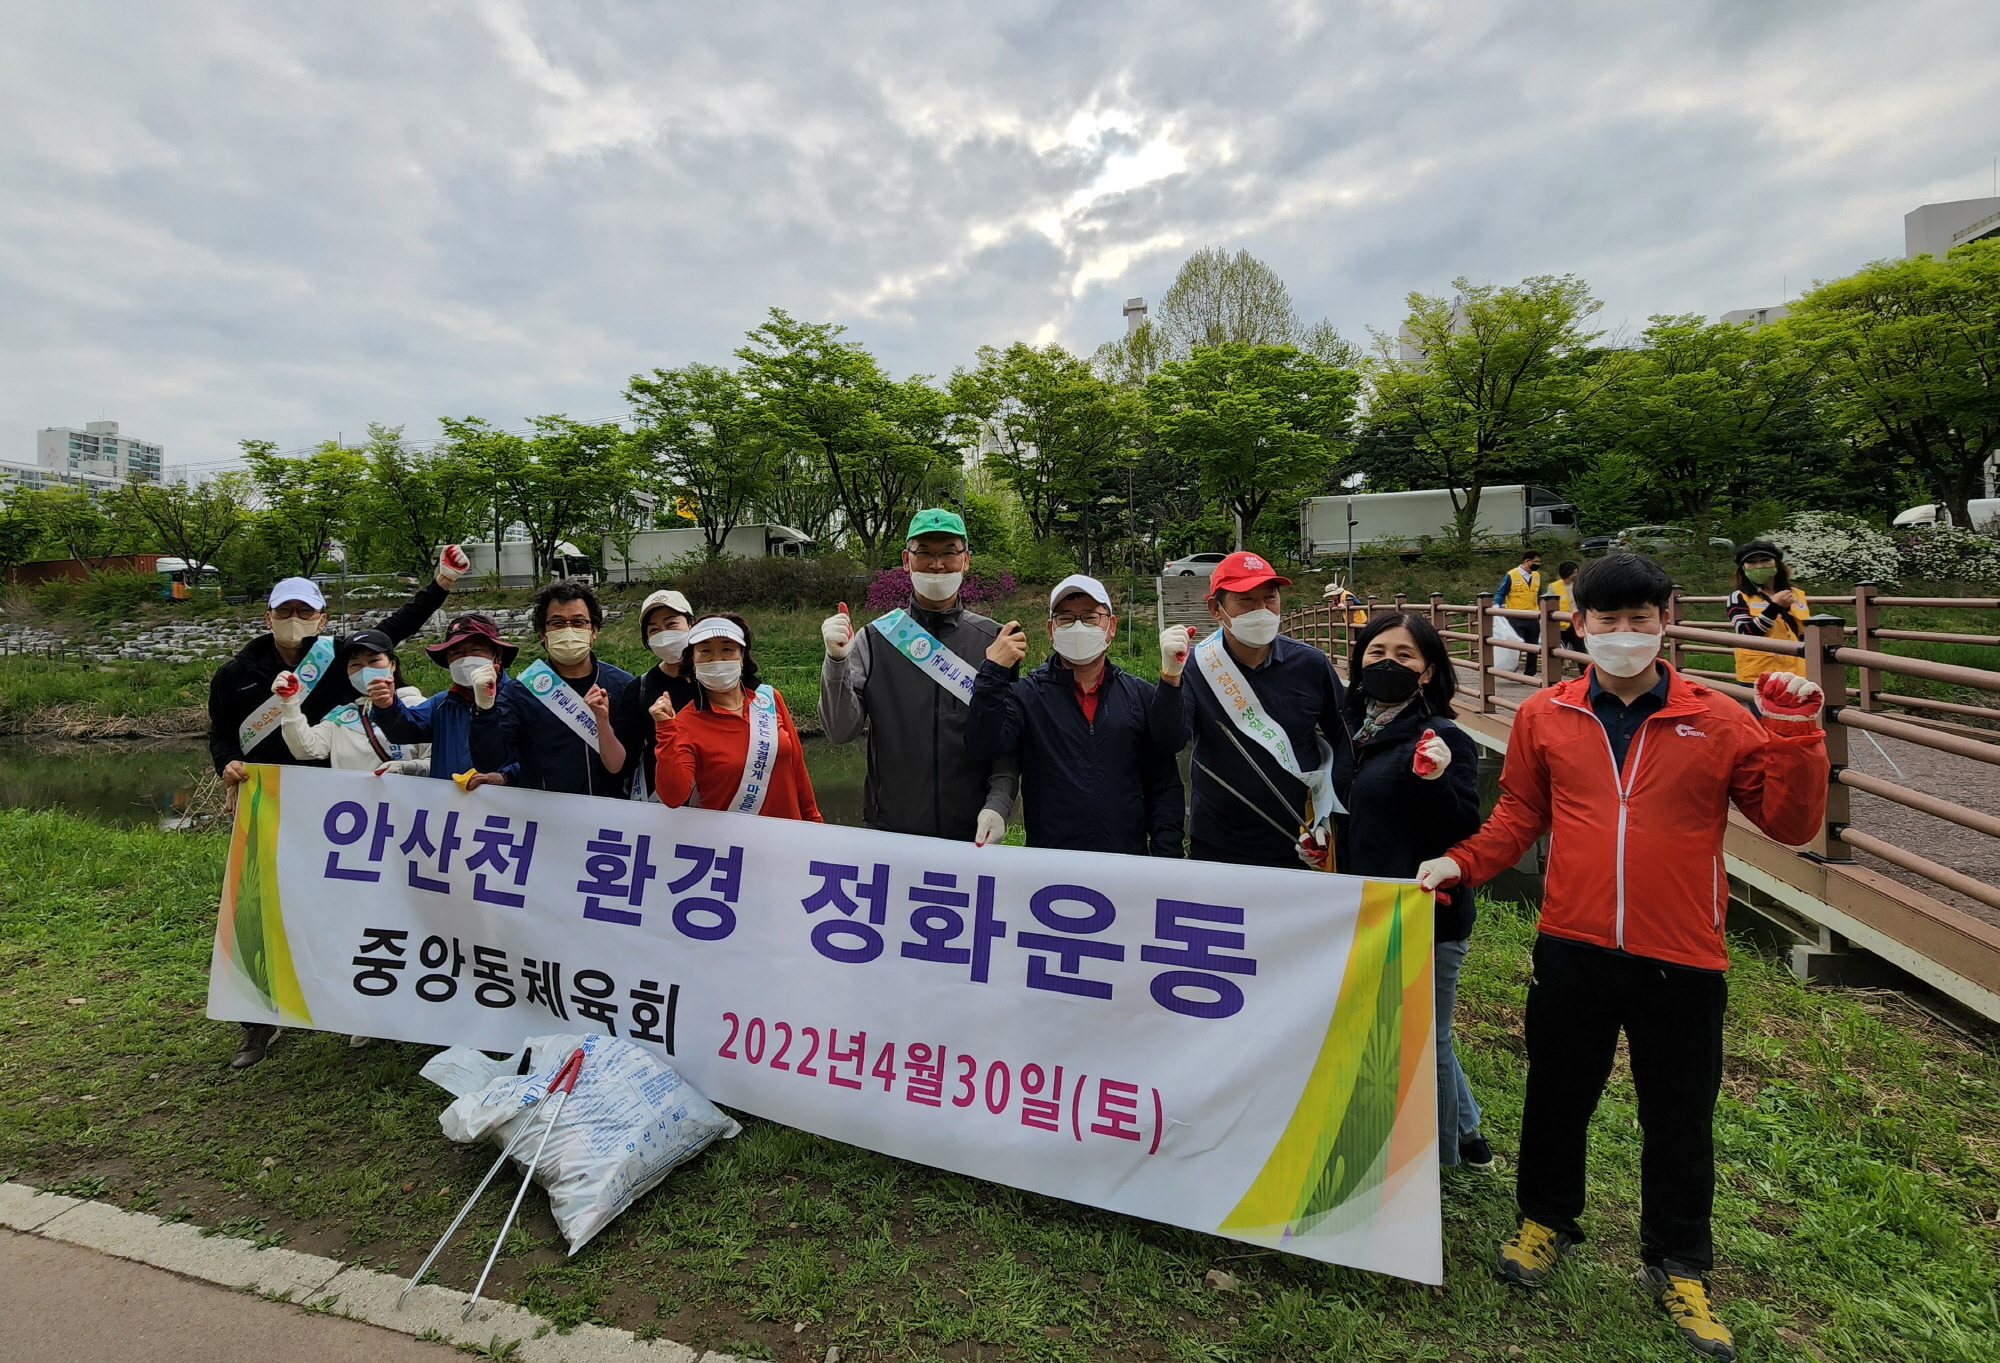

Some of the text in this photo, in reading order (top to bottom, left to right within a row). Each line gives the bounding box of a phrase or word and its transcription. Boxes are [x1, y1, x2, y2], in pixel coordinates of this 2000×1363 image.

[930, 654, 962, 681] 국토는
[550, 688, 579, 715] 국토는
[1216, 671, 1249, 711] 절약을
[1241, 706, 1277, 741] 생활화
[757, 711, 771, 738] 국토는
[1687, 729, 1707, 738] NEPA
[750, 740, 770, 781] 청결하게
[324, 801, 1257, 1019] 안산천 환경 정화운동
[352, 928, 680, 1057] 중앙동체육회
[718, 1011, 1163, 1155] 2022년4월30일(토)
